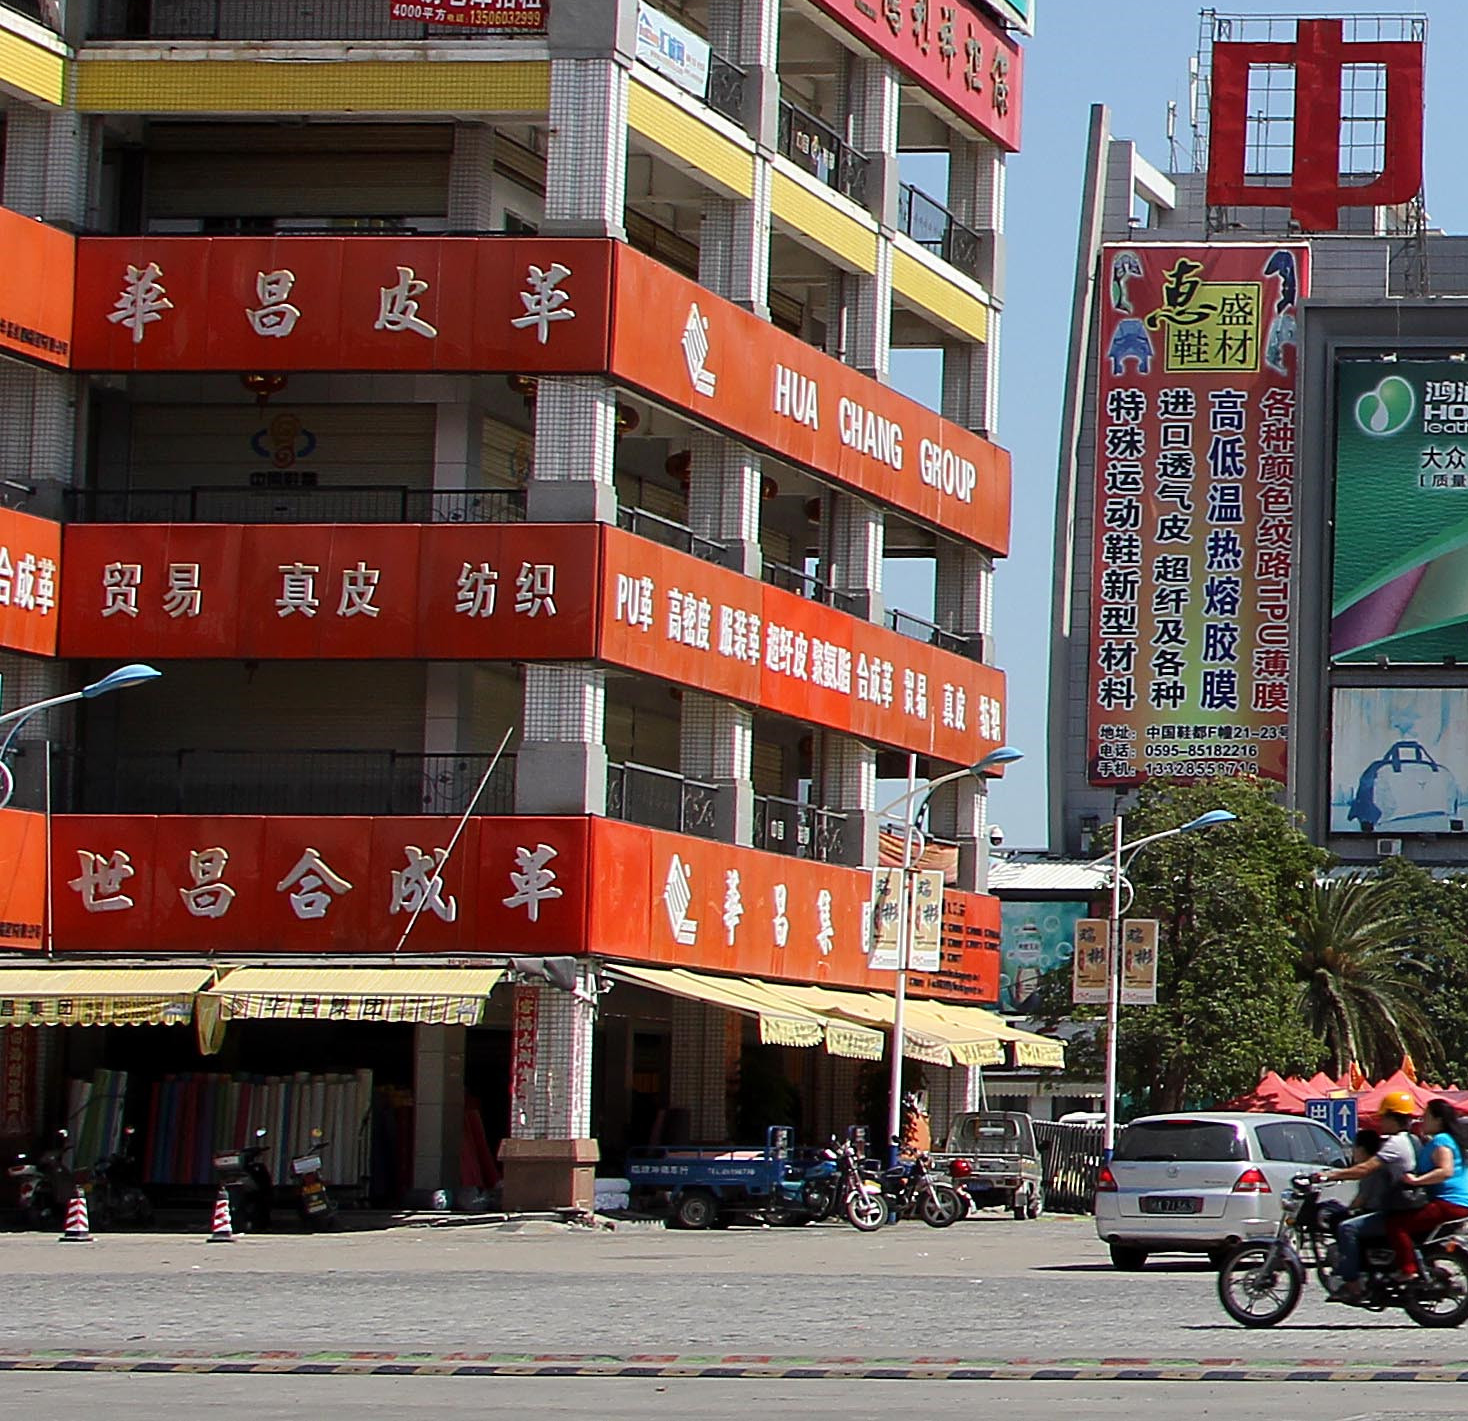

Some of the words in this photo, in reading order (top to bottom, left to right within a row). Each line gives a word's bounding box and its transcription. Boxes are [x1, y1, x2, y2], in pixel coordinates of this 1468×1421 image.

[393, 3, 447, 22] 4000平方
[106, 261, 577, 345] 華昌皮革
[1172, 330, 1253, 365] 鞋材
[774, 362, 820, 432] HUA
[837, 396, 904, 470] CHANG
[919, 436, 977, 504] GROUP
[101, 561, 202, 618] 贸易
[275, 561, 382, 618] 真皮
[456, 561, 557, 618] 纺织
[1100, 389, 1146, 710] 特殊运动鞋新型材料
[1200, 390, 1248, 711] 高低温热熔胶膜
[1251, 388, 1296, 711] 各种颜色纹路TPU薄膜
[615, 573, 655, 631] PU革
[667, 587, 712, 651] 高密度
[718, 604, 762, 666] 服装革
[856, 650, 895, 709] 合成革
[903, 664, 929, 720] 贸易
[942, 682, 967, 732] 真皮
[1098, 762, 1136, 778] 手机:
[1099, 744, 1136, 758] 电话:
[1145, 744, 1258, 758] 0595-85182216
[67, 844, 564, 923] 世昌合成革
[722, 866, 872, 957] 華昌集
